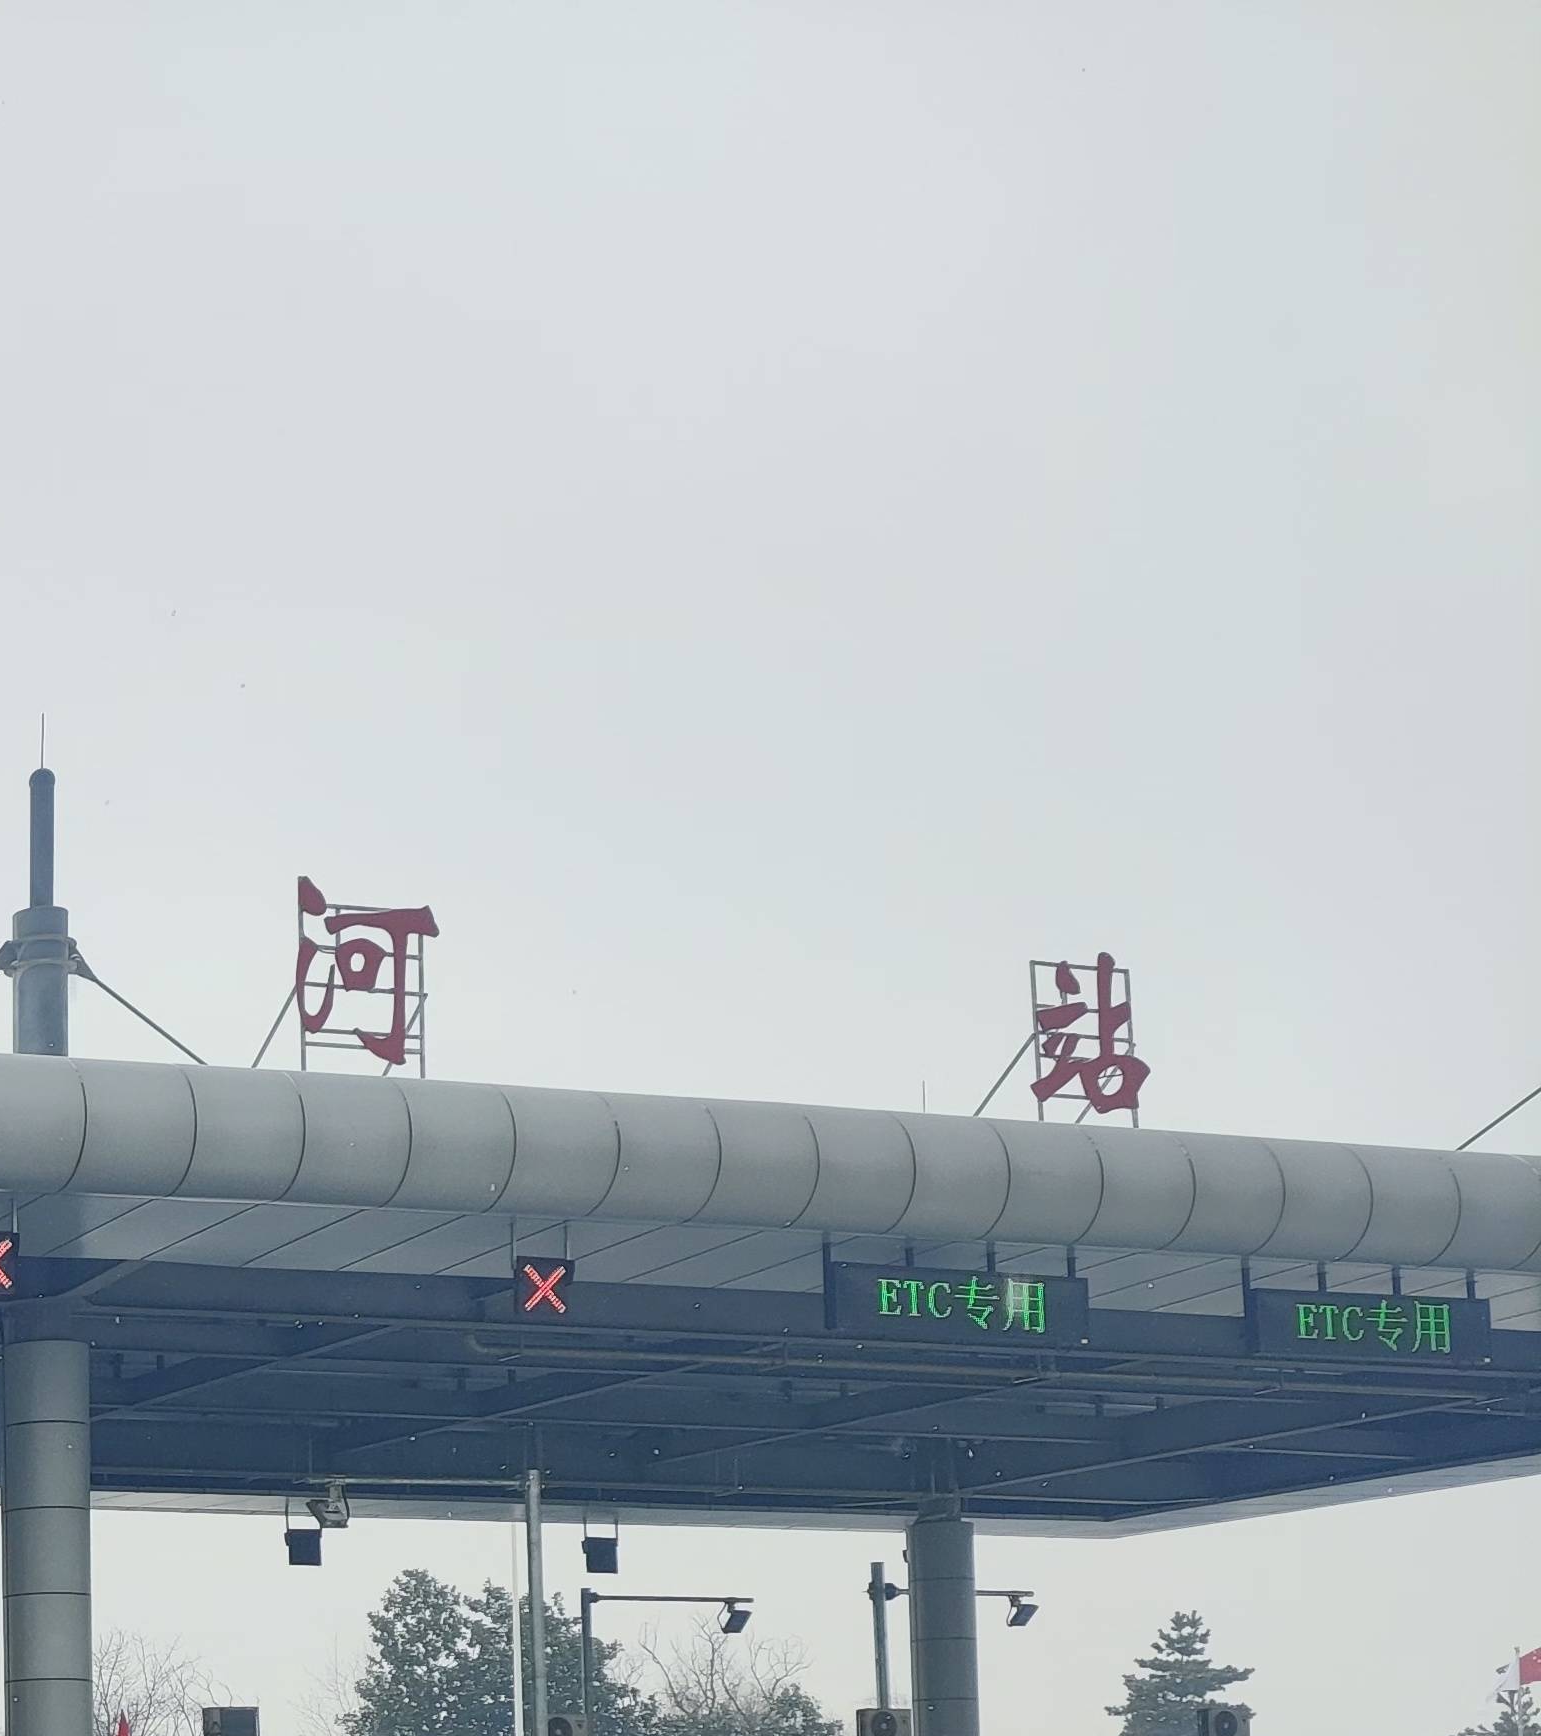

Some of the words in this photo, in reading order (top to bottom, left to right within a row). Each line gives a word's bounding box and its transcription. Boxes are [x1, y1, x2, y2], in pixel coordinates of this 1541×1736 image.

[296, 875, 440, 1065] 河
[1030, 951, 1151, 1114] 站
[877, 1275, 1045, 1333] ETC专用
[1295, 1299, 1451, 1354] ETC专用
